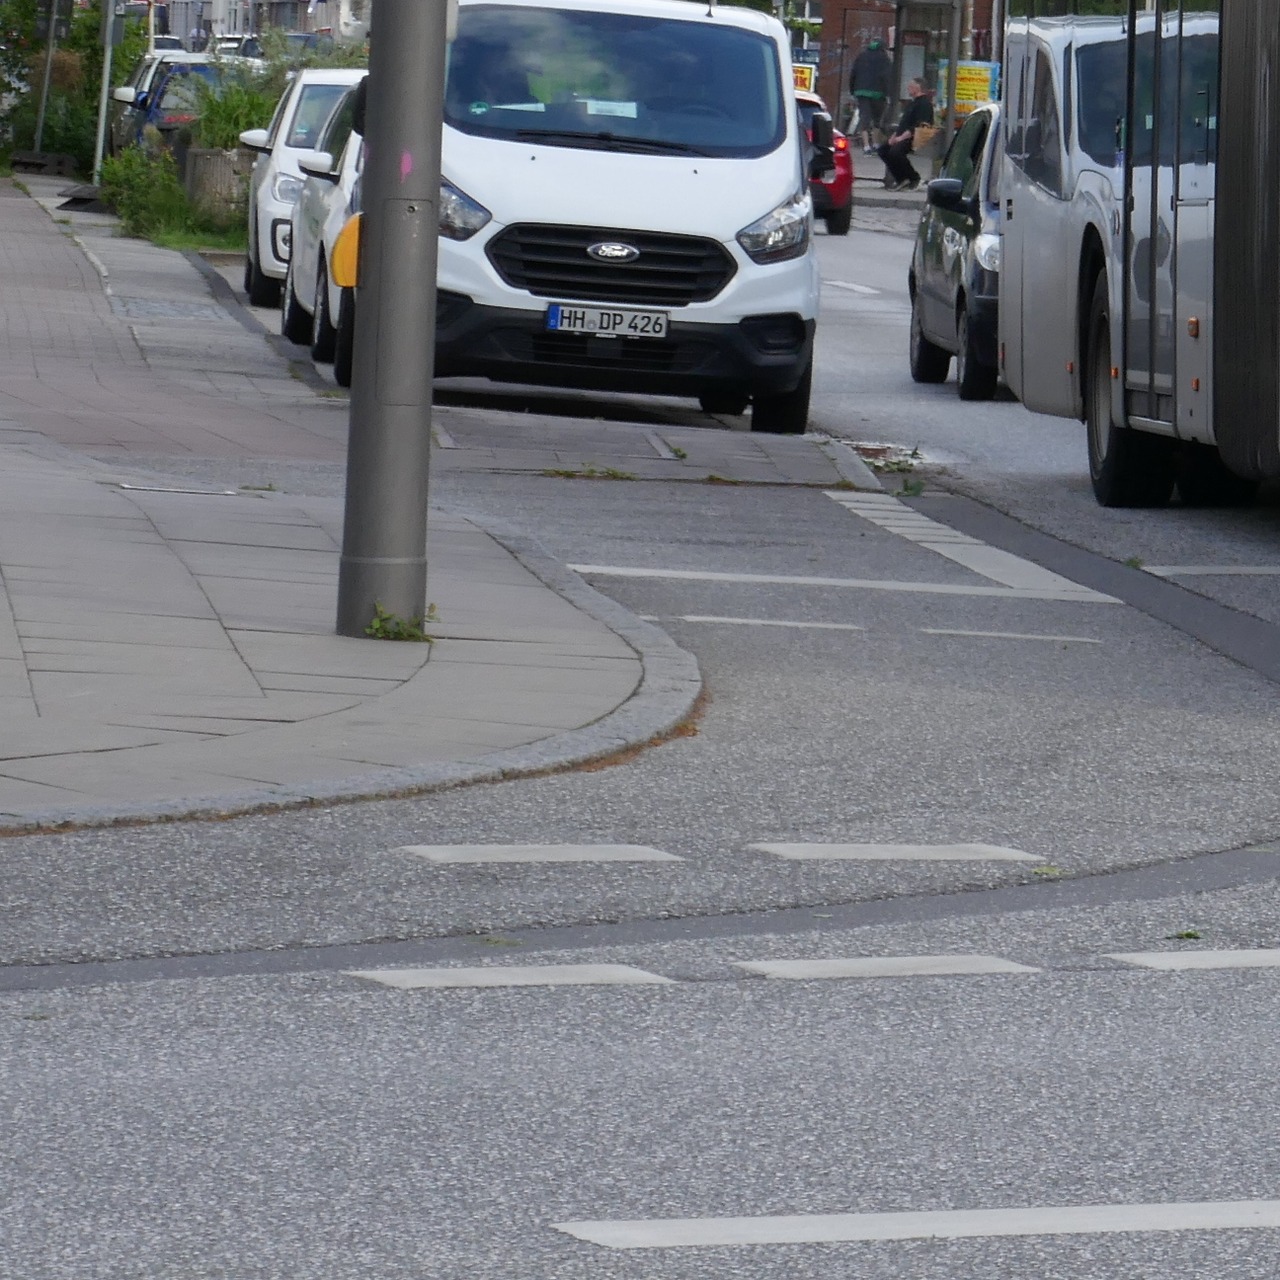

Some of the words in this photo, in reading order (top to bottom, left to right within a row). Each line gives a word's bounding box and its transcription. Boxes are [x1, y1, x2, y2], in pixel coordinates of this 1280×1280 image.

[560, 310, 586, 329] HH
[599, 312, 624, 331] DP
[628, 314, 664, 334] 426
